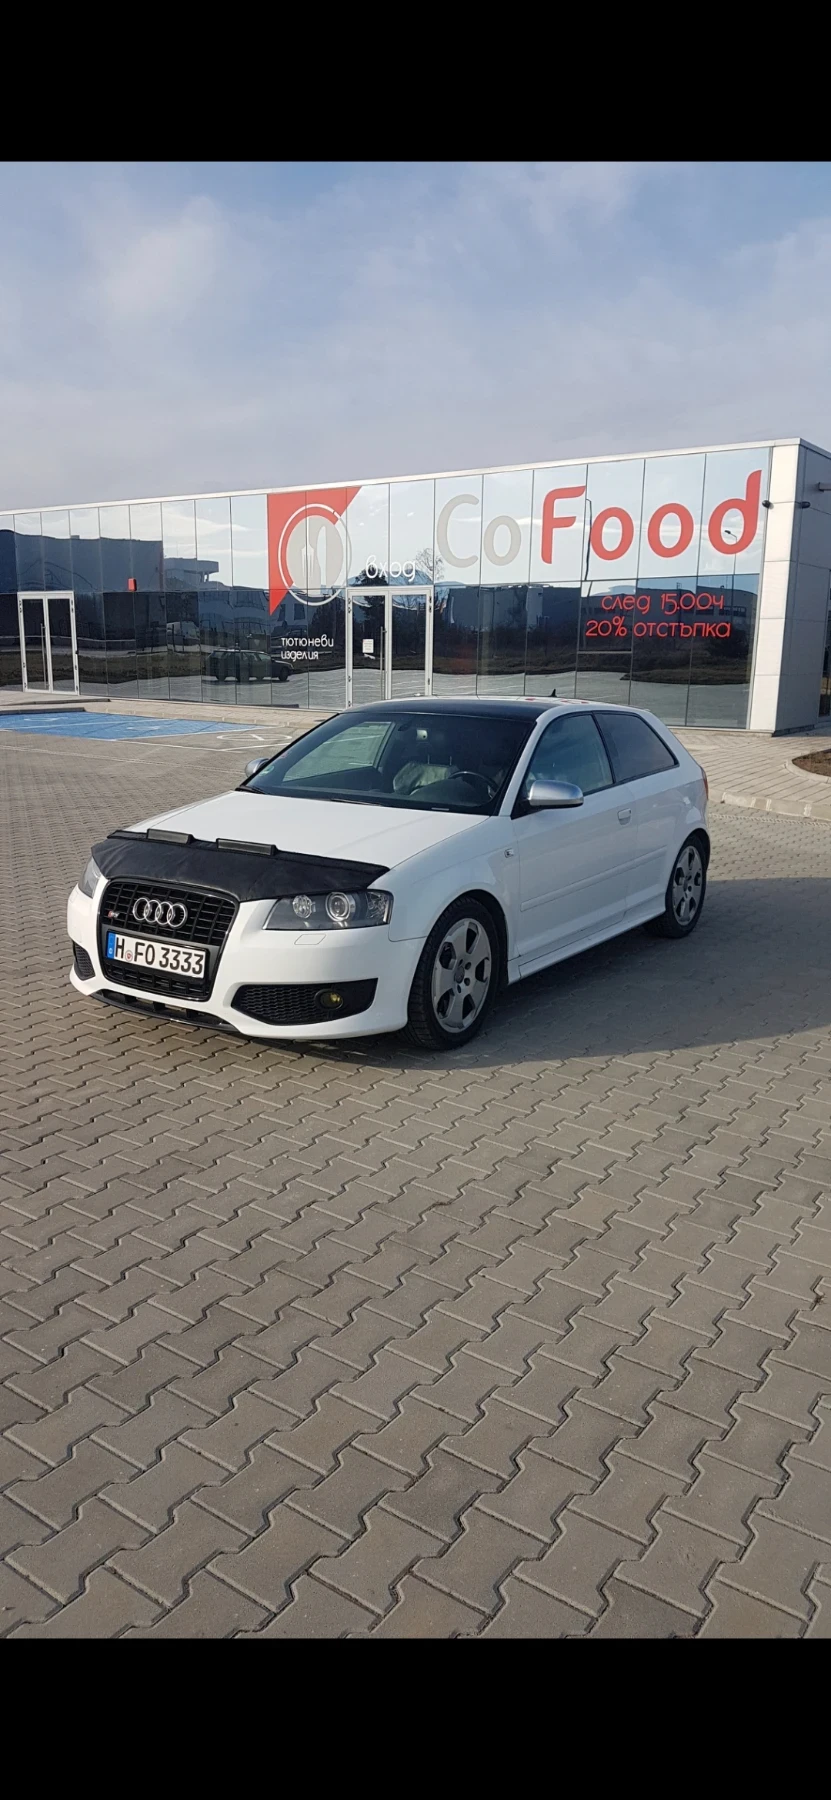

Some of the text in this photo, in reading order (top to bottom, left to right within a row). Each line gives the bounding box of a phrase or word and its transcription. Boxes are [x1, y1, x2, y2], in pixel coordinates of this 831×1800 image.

[365, 555, 416, 582] вход
[601, 592, 724, 615] след 15.00ч
[585, 616, 731, 638] 20% отстъпка
[281, 634, 334, 647] тютюневи
[281, 650, 319, 662] изделия
[115, 937, 204, 975] H FO 3333
